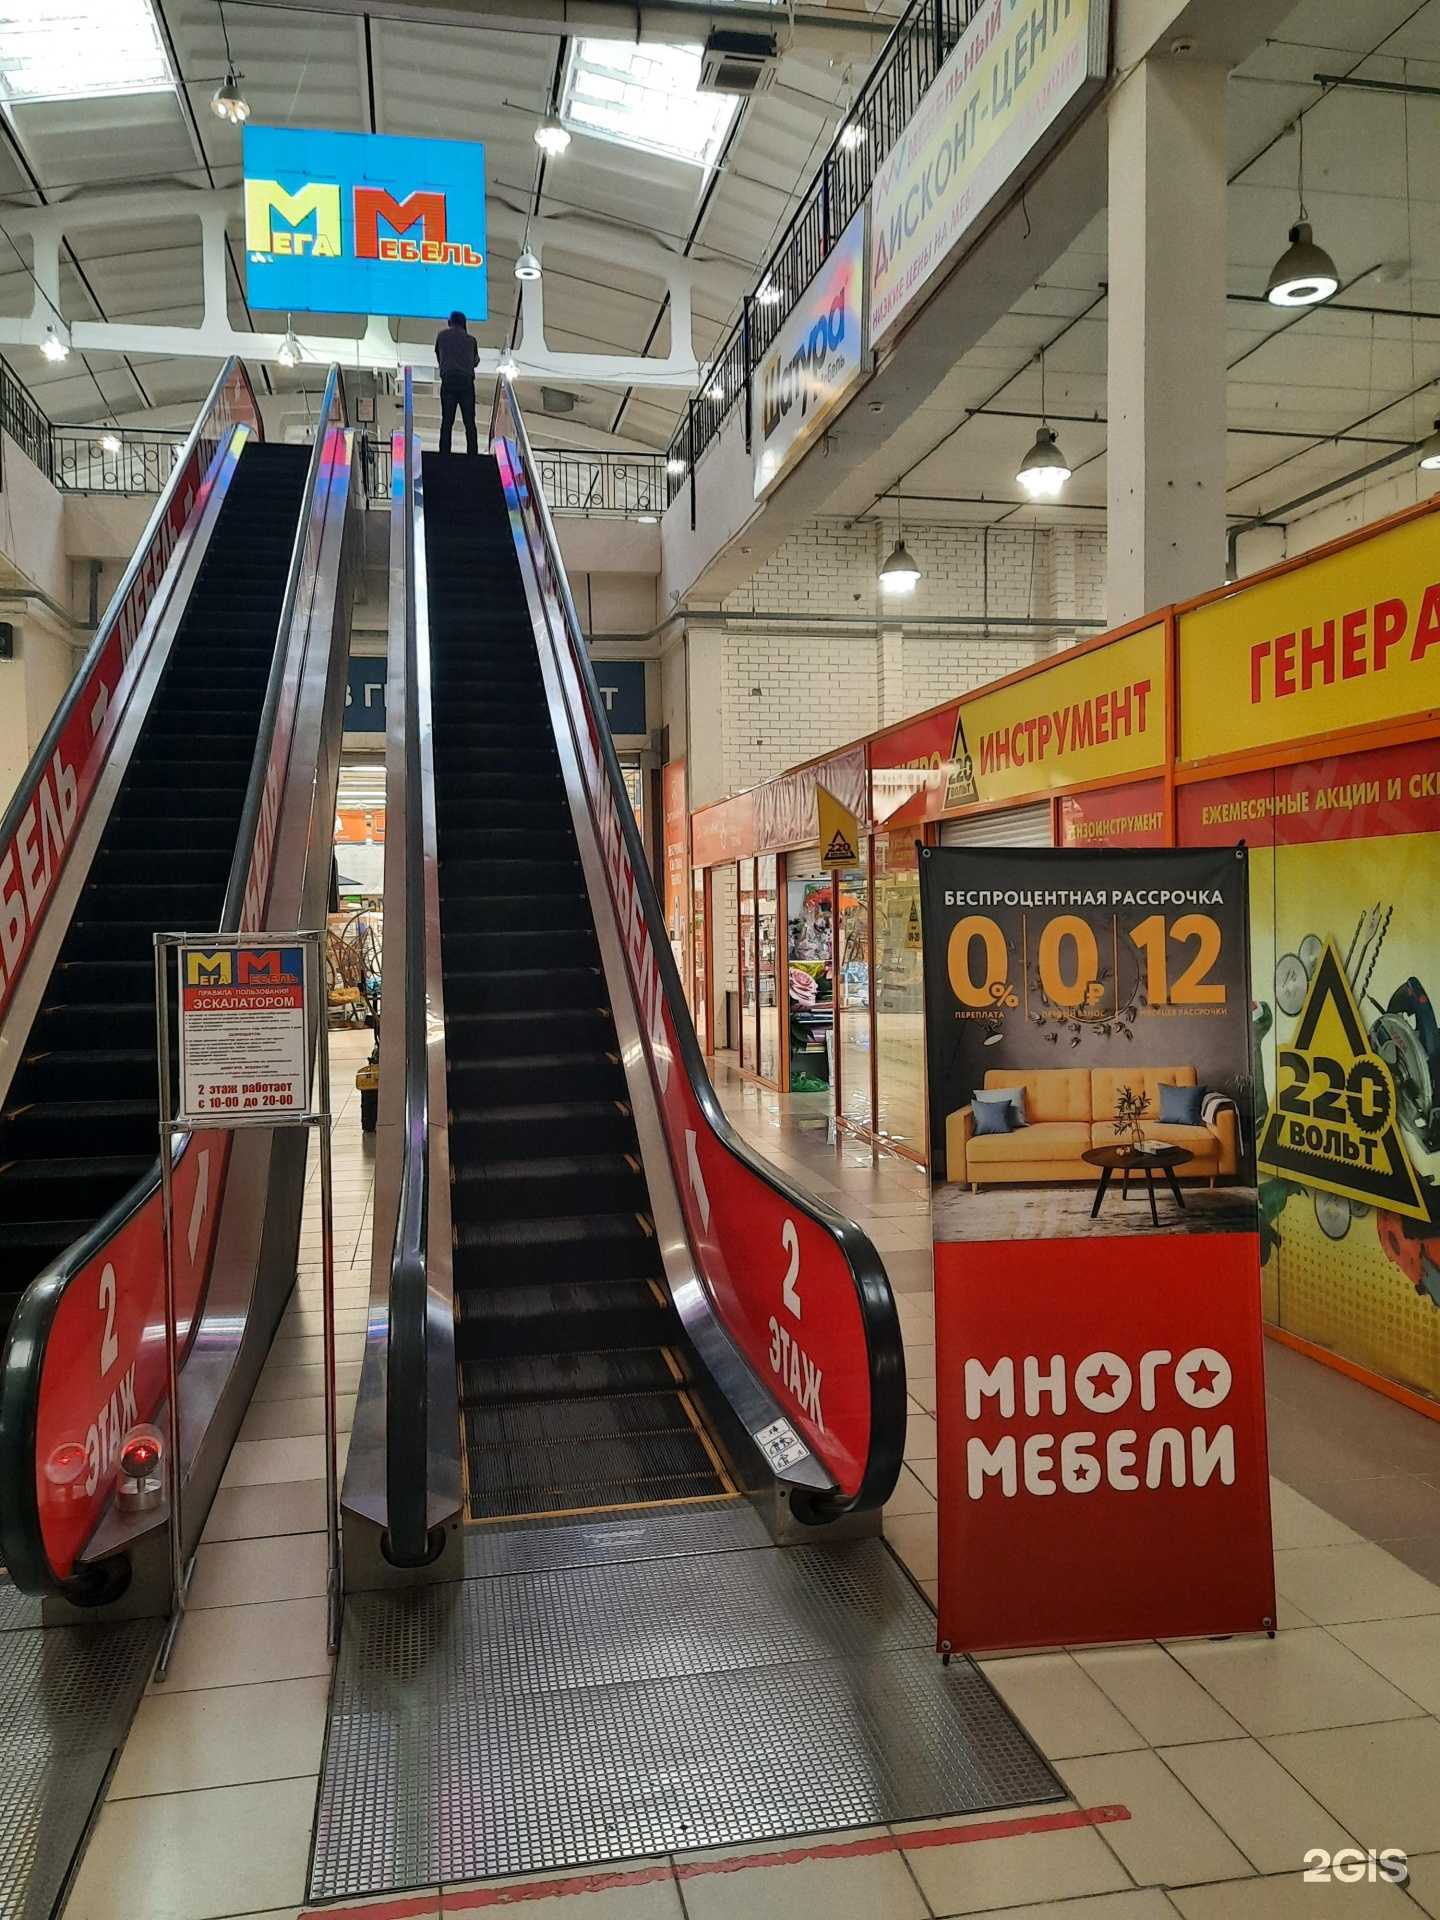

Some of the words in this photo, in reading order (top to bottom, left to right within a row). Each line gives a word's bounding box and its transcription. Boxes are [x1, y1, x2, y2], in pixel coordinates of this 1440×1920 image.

[244, 178, 341, 257] МЕГА
[353, 185, 484, 268] МЕБЕЛЬ
[872, 275, 905, 332] НИЗКИЕ
[905, 246, 932, 290] ЦЕНЫ
[934, 226, 949, 255] НА
[979, 679, 1152, 777] ИНСТРУМЕНТ
[1202, 790, 1310, 826] ЕЖЕМЕСЯЧНЫЕ
[1315, 779, 1381, 812] АКЦИИ
[1387, 774, 1402, 800] И
[1408, 771, 1440, 799] СК
[0, 748, 78, 1010] БЕЛЬ
[944, 890, 1107, 907] БЕСПРОЦЕНТНАЯ
[1111, 889, 1224, 905] РАССРОЧКА
[187, 951, 232, 985] МЕГА
[198, 989, 232, 997] ПРАВИЛА
[236, 988, 289, 996] ПОЛЬЗОВАНИЯ
[1129, 913, 1226, 1005] 12
[193, 997, 295, 1009] ЭСКАЛАТОРОМ
[954, 1010, 1005, 1020] ПЕРЕПЛАТА
[1178, 1007, 1228, 1017] РАССРОЧКИ
[198, 1084, 205, 1095] 2
[209, 1083, 238, 1095] этаж
[242, 1081, 293, 1095] работает
[210, 1097, 239, 1108] 10-00
[243, 1097, 258, 1109] до
[262, 1094, 294, 1106] 20-00
[1278, 1050, 1394, 1136] 220
[1288, 1120, 1379, 1166] ВОЛЬТ
[783, 1219, 801, 1321] 2
[99, 1262, 118, 1377] 2
[769, 1315, 825, 1435] ЭТАЖ
[964, 1347, 1233, 1421] МНОГО
[85, 1359, 138, 1497] ЭТАЖ
[966, 1424, 1236, 1500] МЕБЕЛИ
